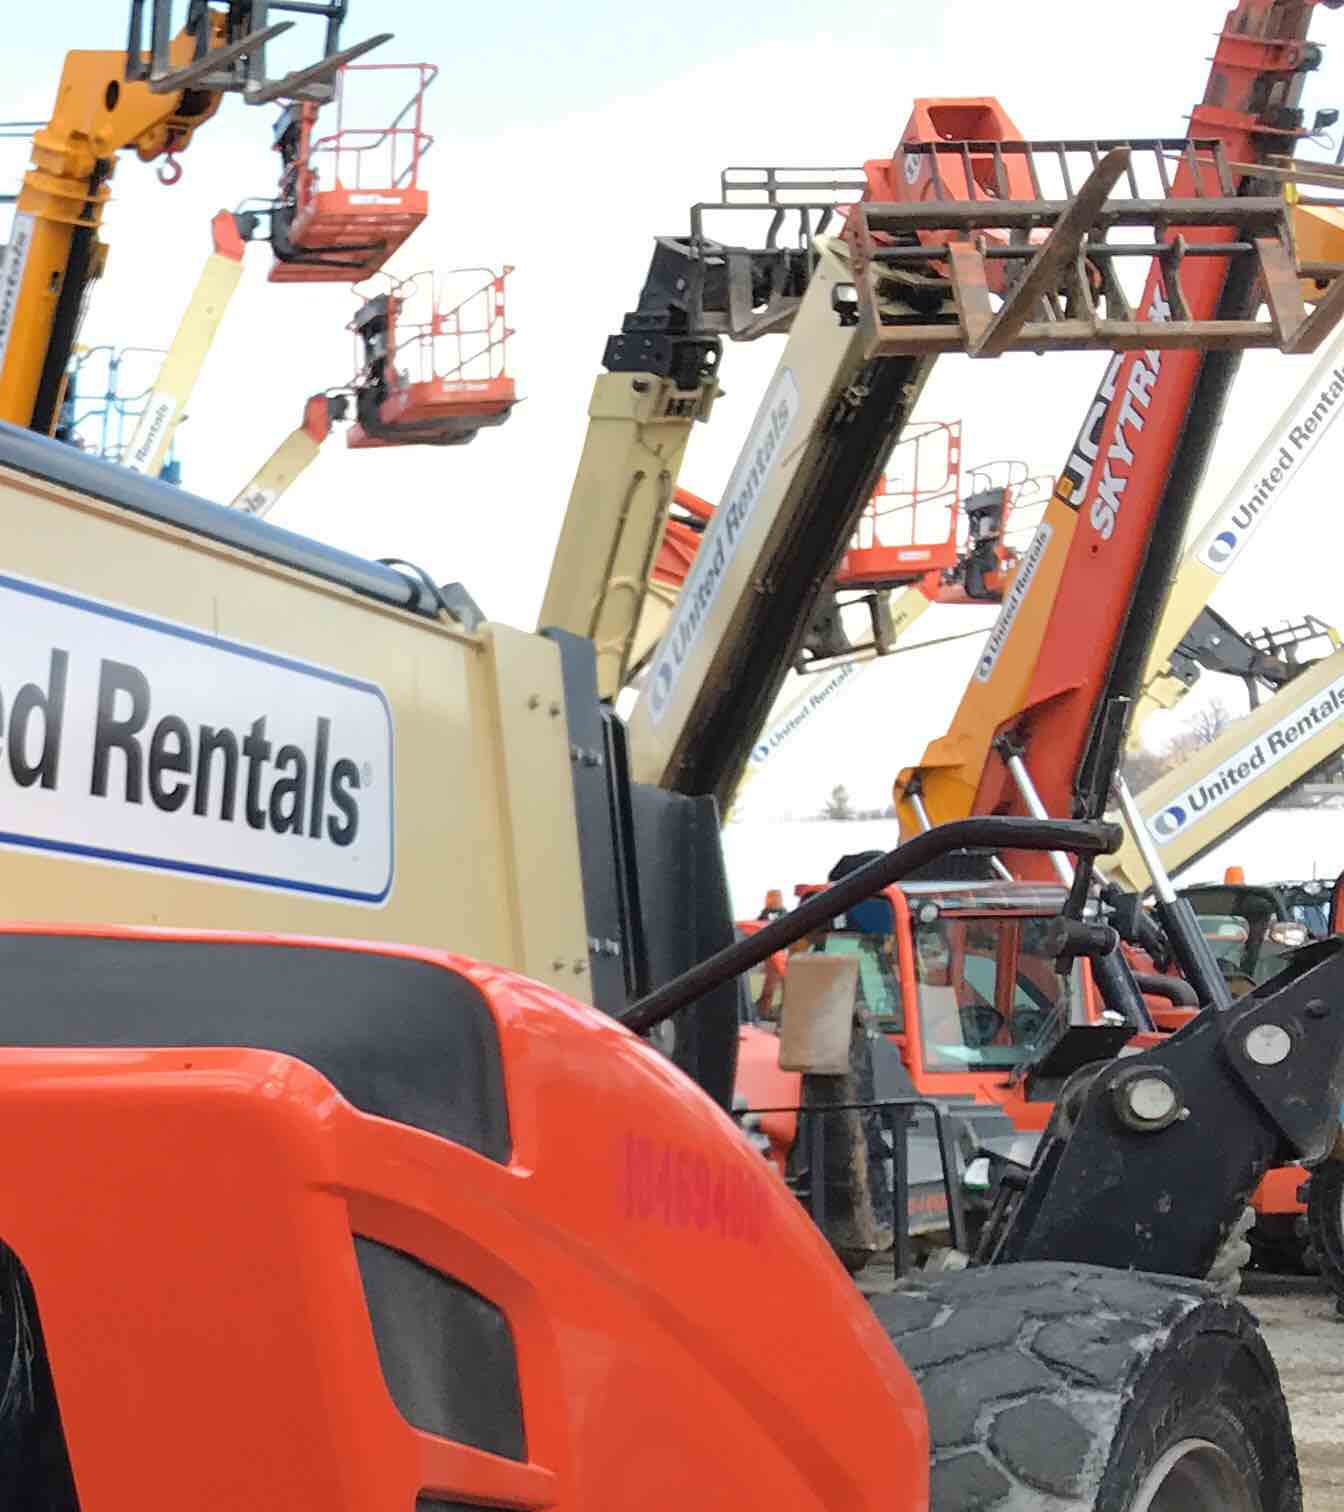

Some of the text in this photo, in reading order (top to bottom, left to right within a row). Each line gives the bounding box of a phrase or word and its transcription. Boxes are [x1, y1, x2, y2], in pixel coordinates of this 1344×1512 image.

[1090, 284, 1171, 540] SKYTRK
[1231, 368, 1344, 530] United Rental
[671, 402, 791, 667] United Rentals
[989, 531, 1048, 654] United Rentals
[90, 657, 362, 848] Rentals
[1187, 745, 1266, 812] United
